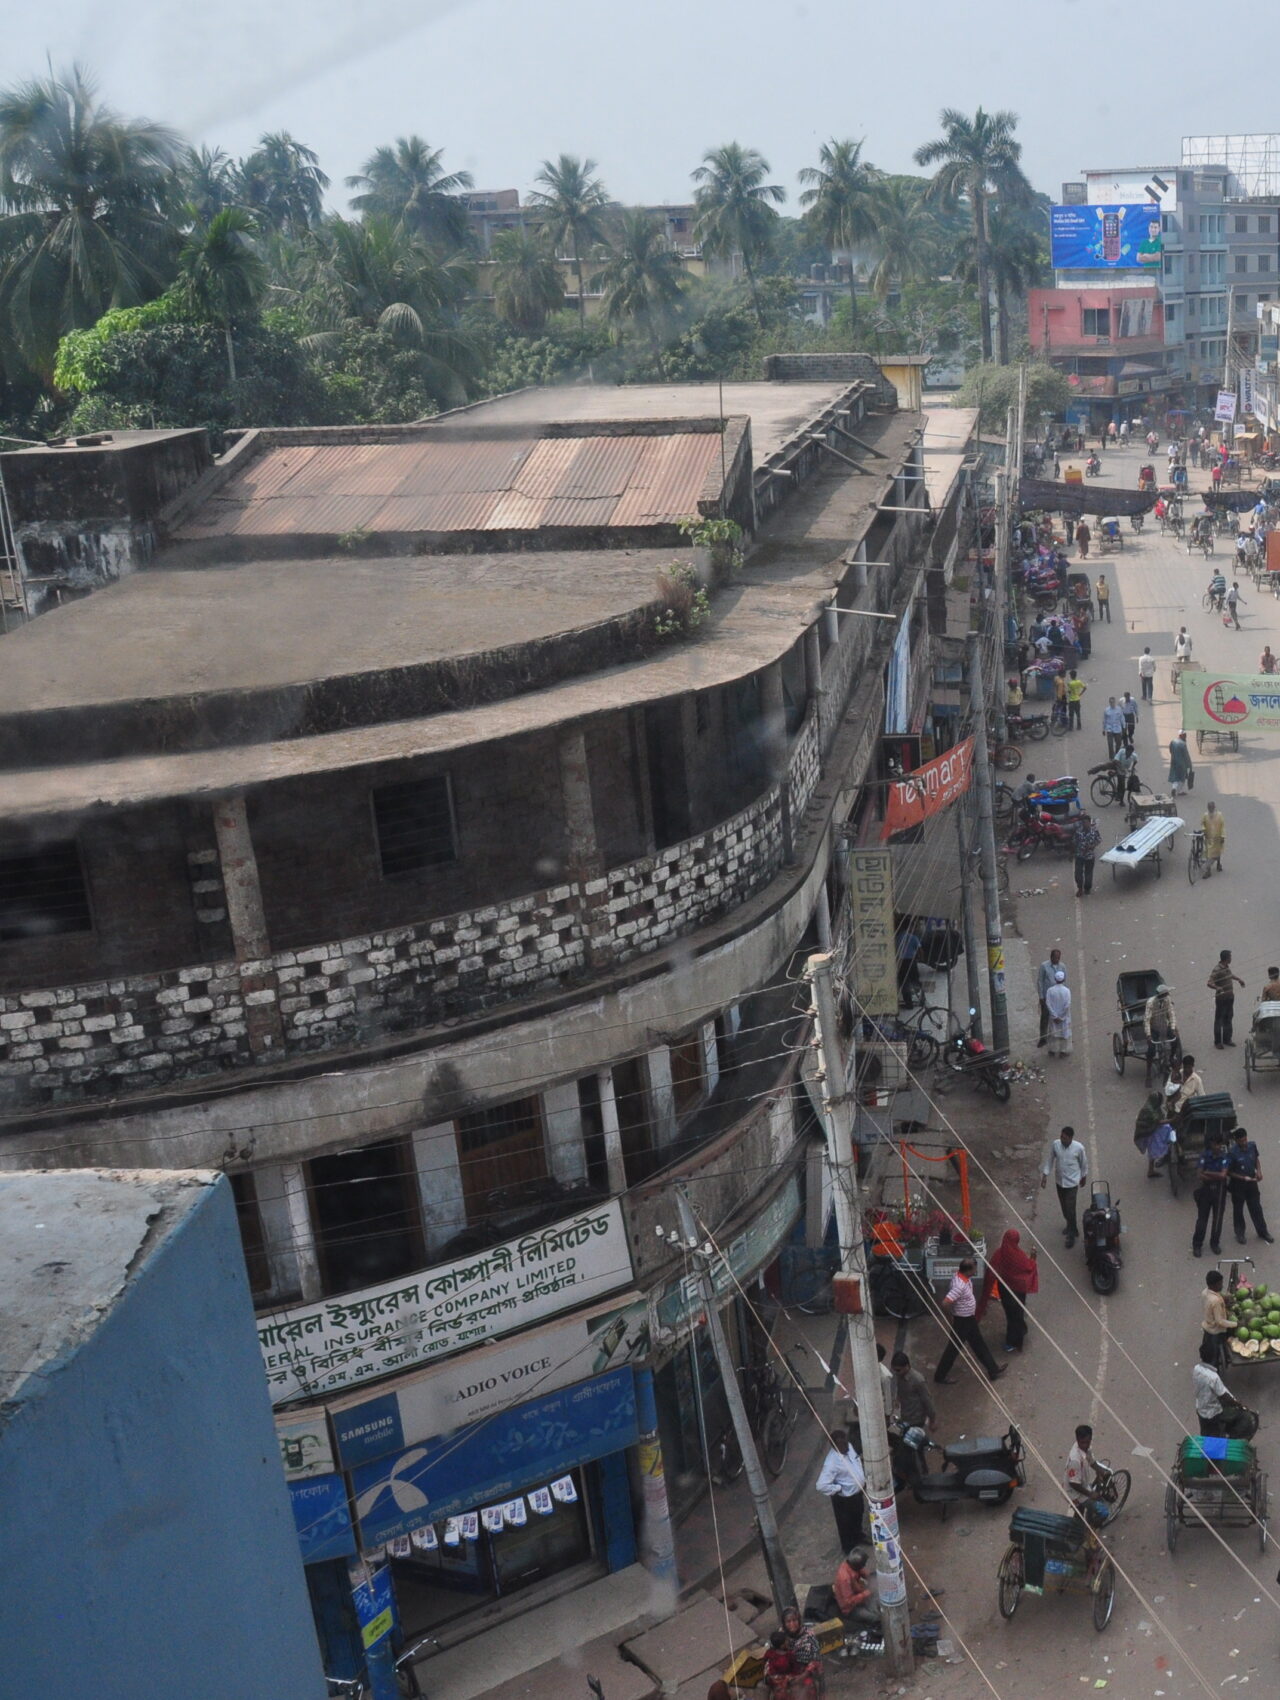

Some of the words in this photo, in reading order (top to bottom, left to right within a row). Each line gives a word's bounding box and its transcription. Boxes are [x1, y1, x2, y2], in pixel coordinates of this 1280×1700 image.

[425, 1247, 514, 1300] কোম্পানী
[518, 1212, 610, 1267] লিমিটেড
[324, 1310, 428, 1351] INSURANCE
[434, 1282, 510, 1317] COMPANY
[516, 1257, 577, 1289] LIMITED
[429, 1296, 518, 1336] নির্ভরযোগ্য
[500, 1356, 551, 1384] VOICE
[341, 1416, 393, 1442] SAMSUNG
[364, 1427, 395, 1444] mobile
